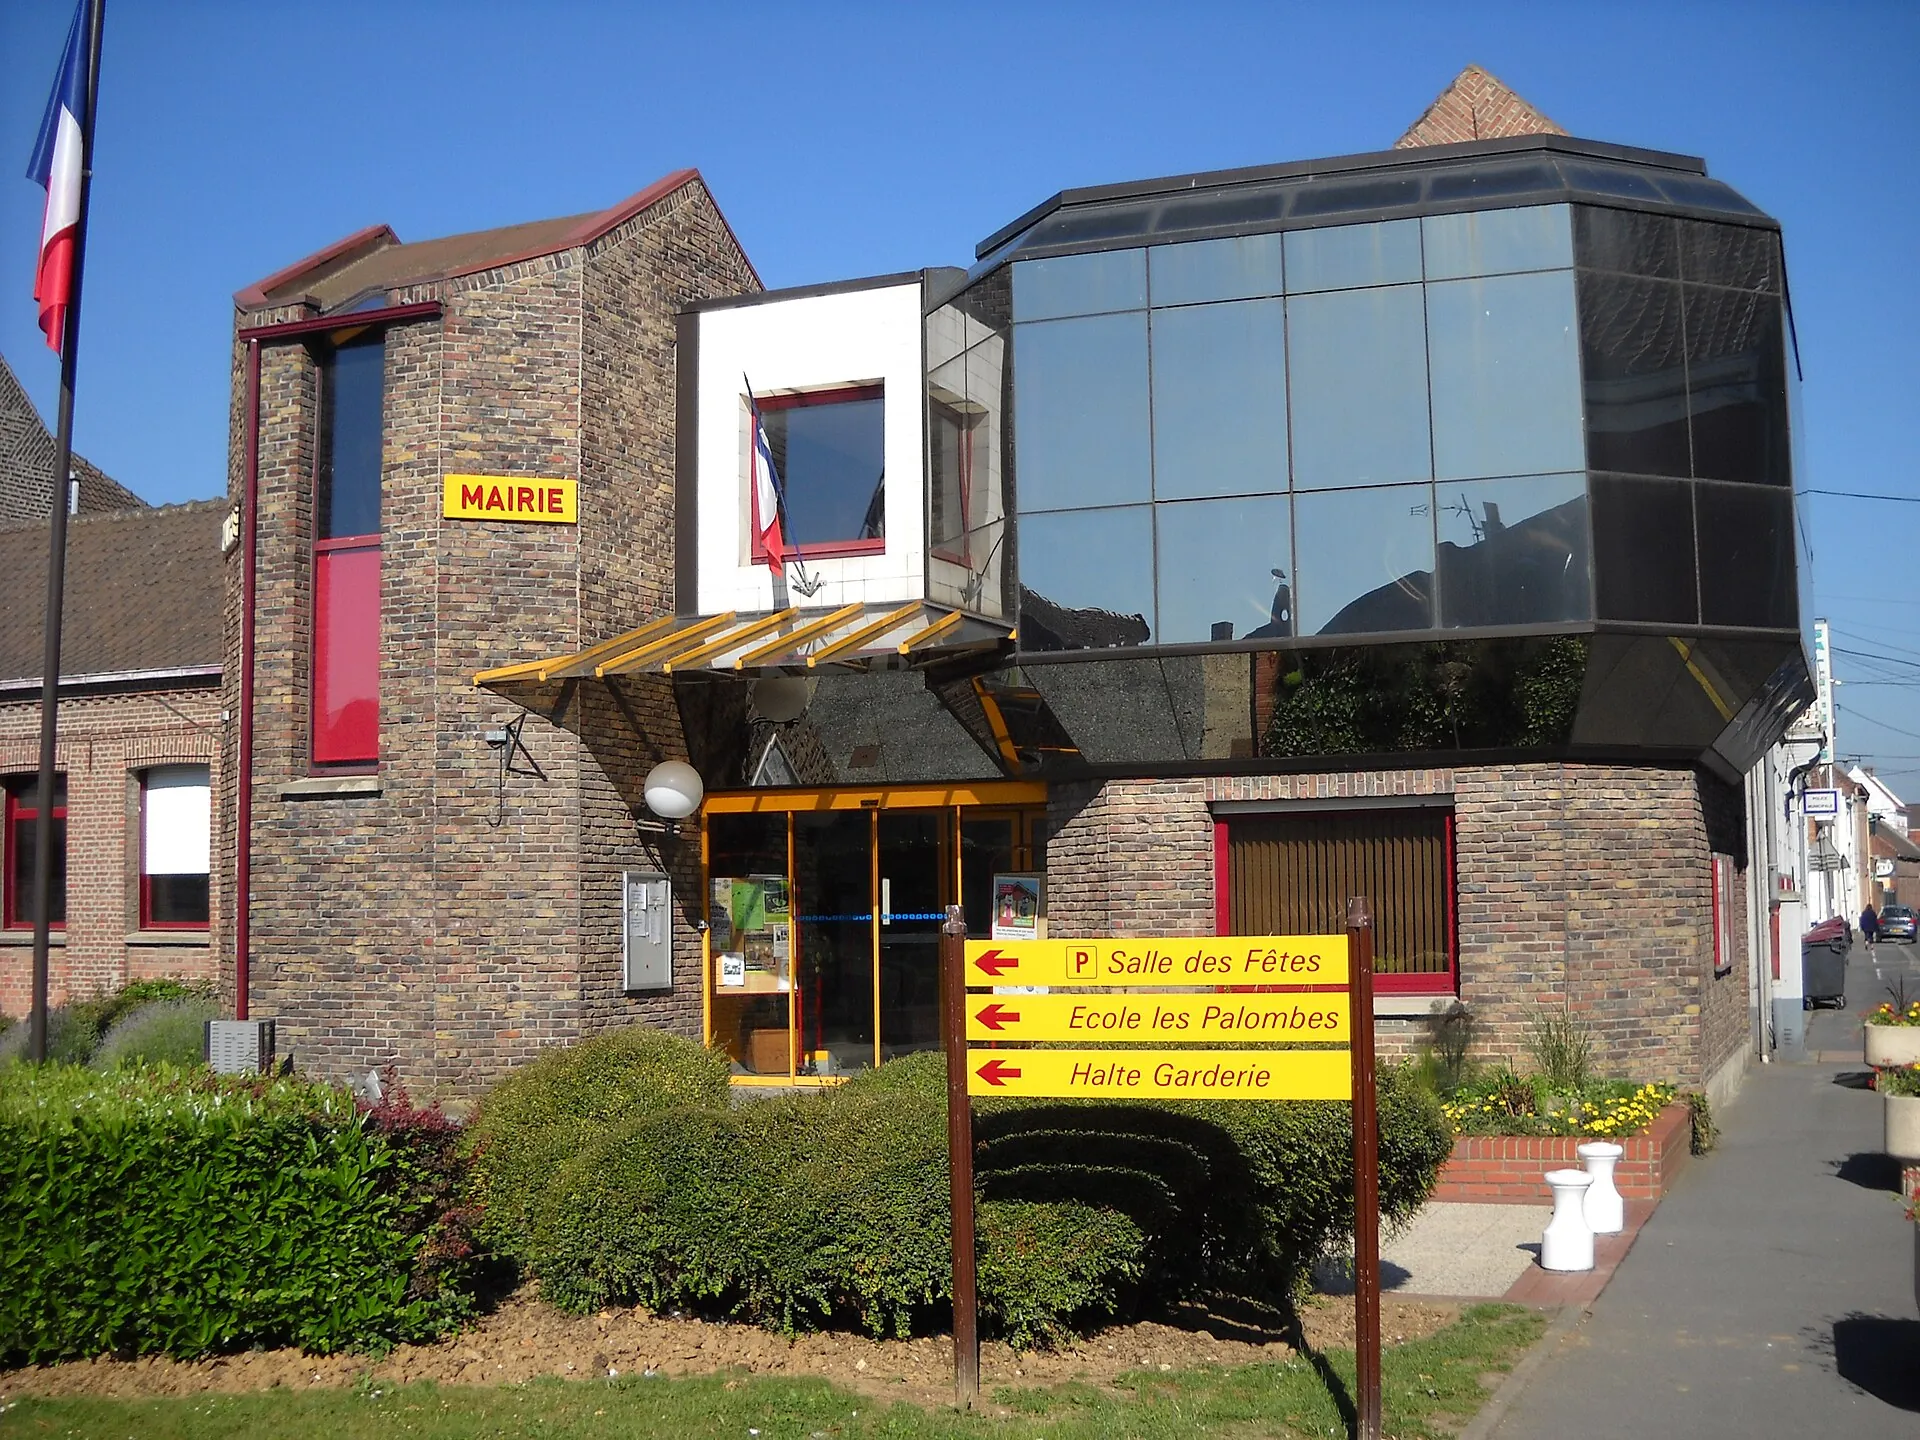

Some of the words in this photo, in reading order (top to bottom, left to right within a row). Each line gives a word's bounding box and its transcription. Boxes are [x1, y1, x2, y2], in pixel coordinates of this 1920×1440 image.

[461, 484, 564, 513] MAIRIE
[1075, 951, 1089, 974] P
[1107, 950, 1173, 974] Salle
[1184, 949, 1233, 974] des
[1244, 948, 1321, 973] Fêtes
[1068, 1006, 1141, 1030] Ecole
[1151, 1006, 1190, 1030] les
[1201, 1005, 1339, 1030] Palombes
[1070, 1062, 1141, 1087] Halte
[1153, 1063, 1271, 1088] Garderie
